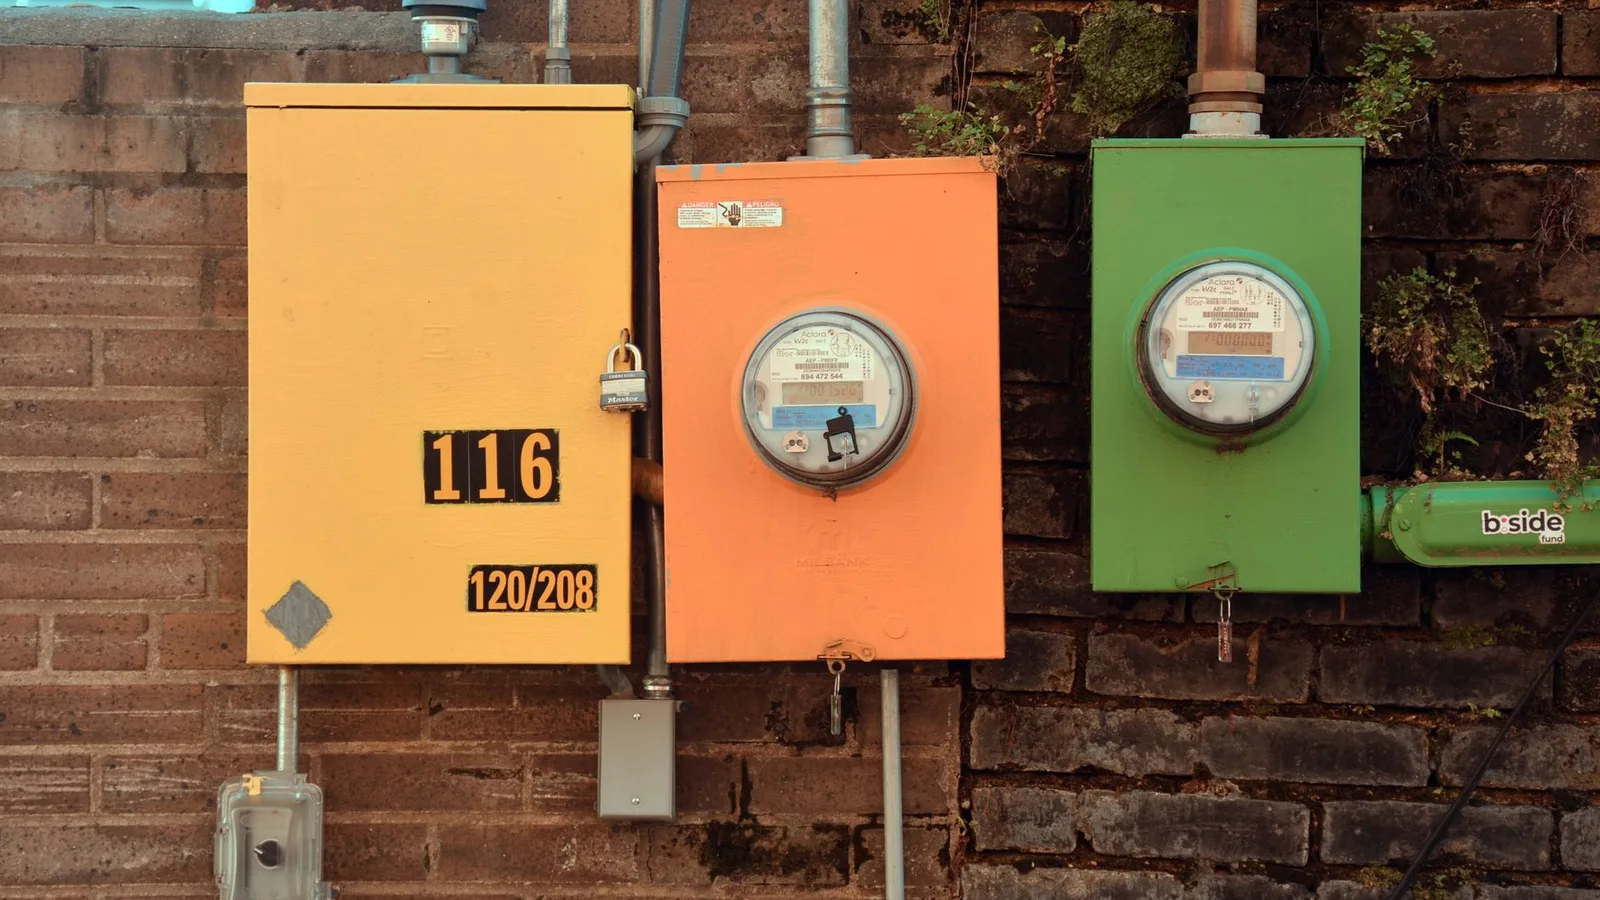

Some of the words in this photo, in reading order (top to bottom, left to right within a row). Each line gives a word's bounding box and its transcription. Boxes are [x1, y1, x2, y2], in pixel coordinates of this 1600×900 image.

[433, 432, 553, 500] 116
[1541, 535, 1563, 543] fund
[471, 566, 594, 612] 120/208
